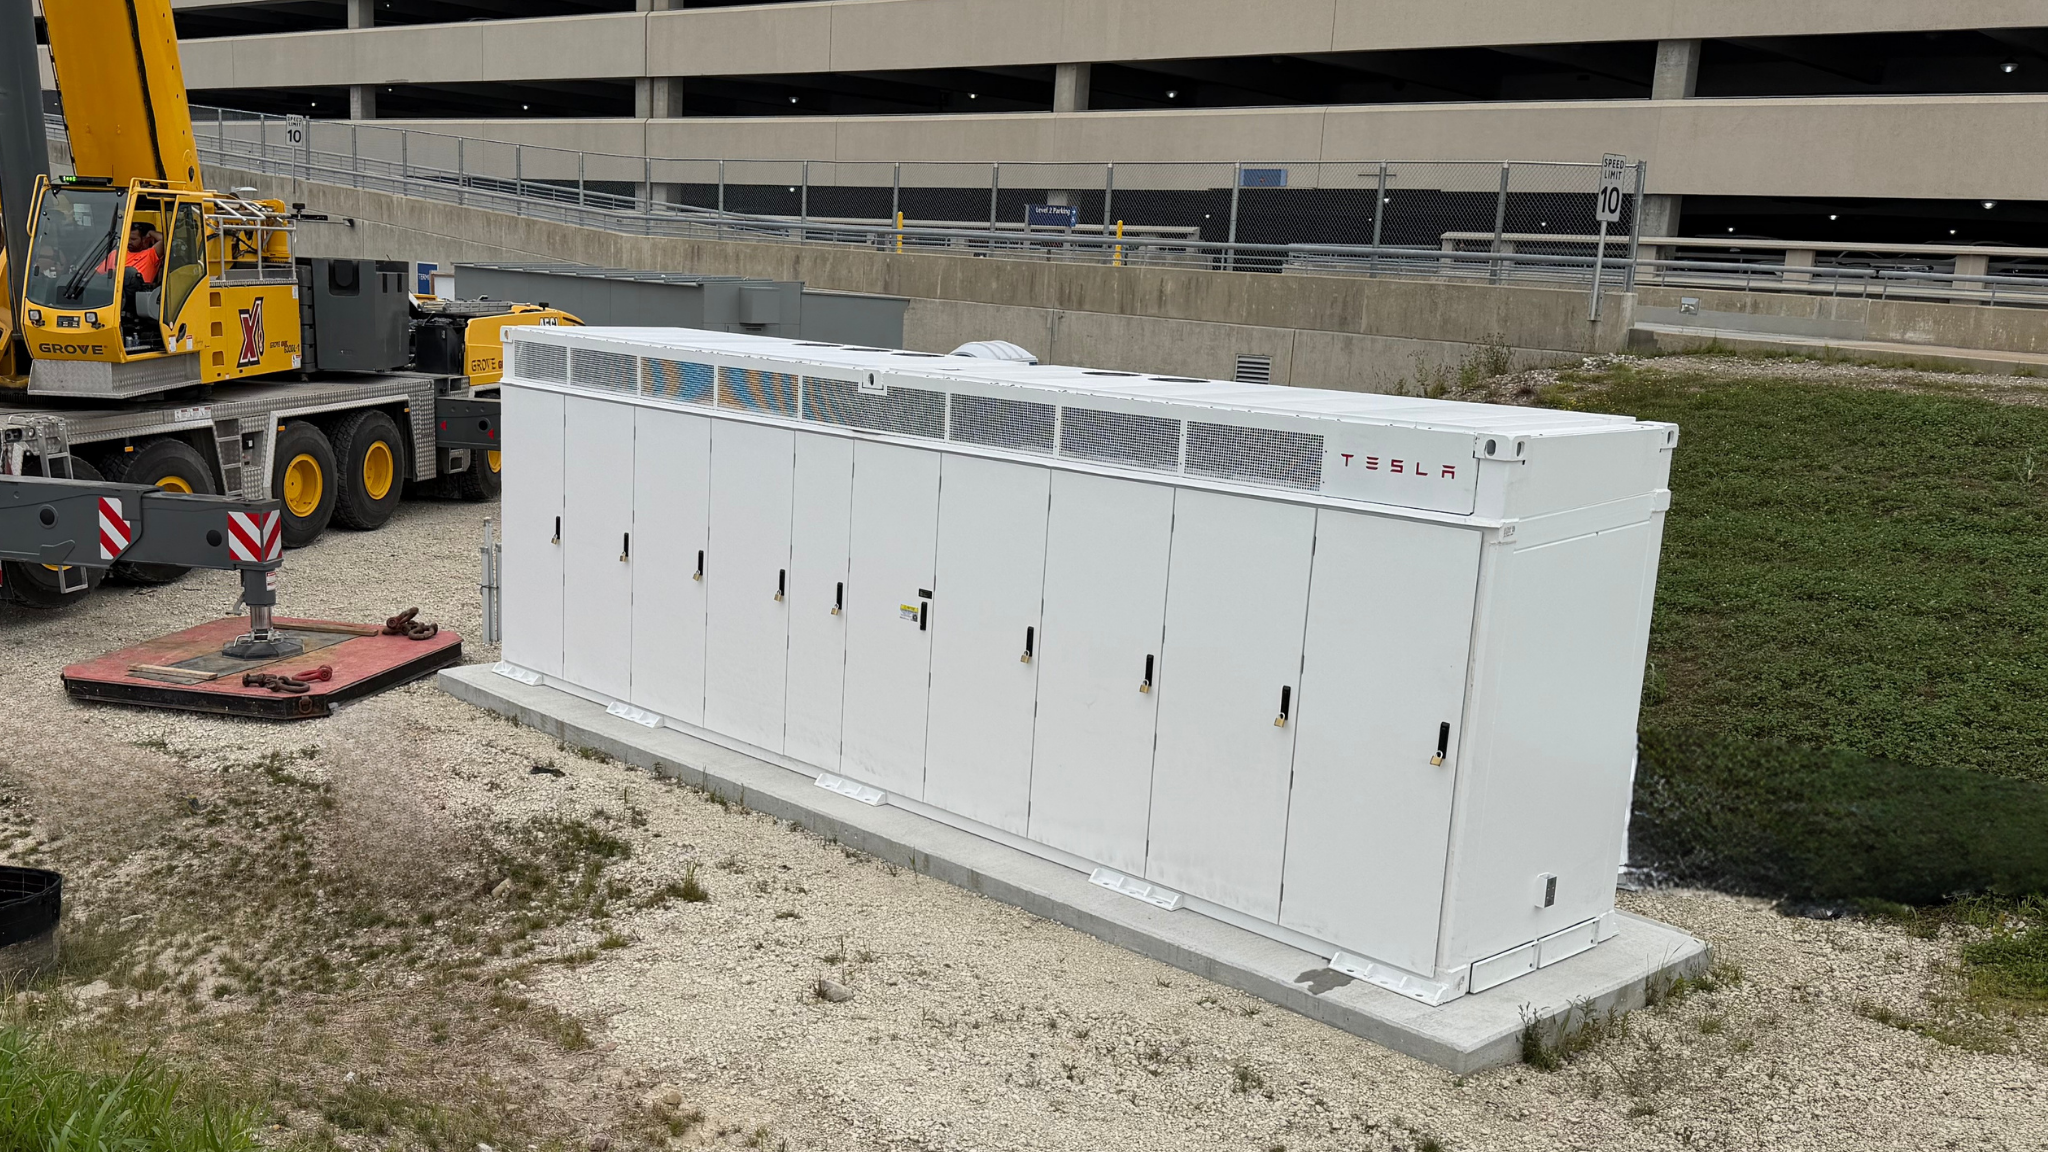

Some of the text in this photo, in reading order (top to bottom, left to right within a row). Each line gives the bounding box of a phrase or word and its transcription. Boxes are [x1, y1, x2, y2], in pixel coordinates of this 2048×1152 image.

[287, 129, 302, 143] 10
[1604, 158, 1625, 169] SPEED
[1604, 170, 1622, 180] LIMIT
[1601, 186, 1620, 214] 10
[1053, 207, 1071, 217] Parking
[39, 343, 104, 355] GROVE
[471, 358, 496, 372] GROVE
[1341, 453, 1456, 479] TESLA
